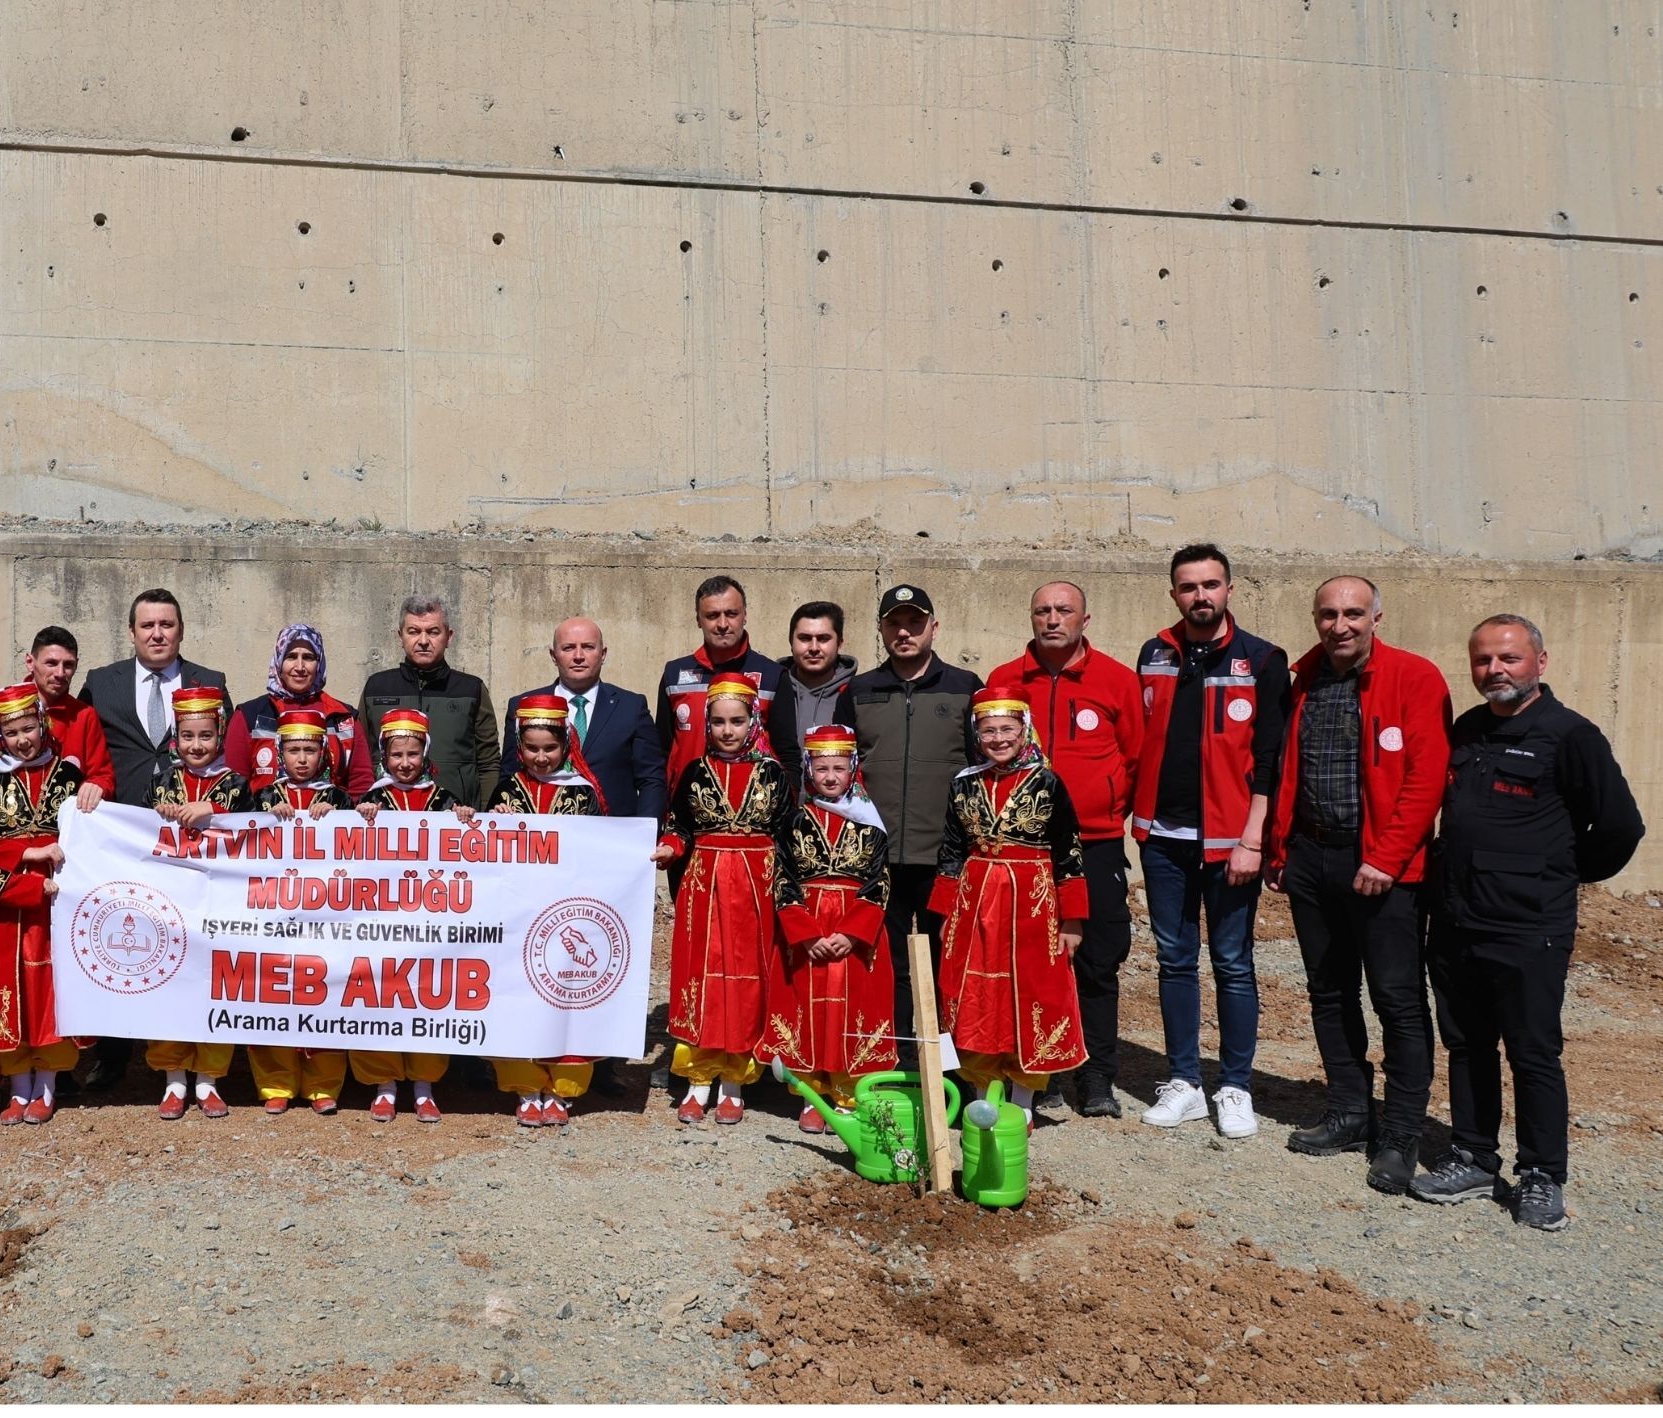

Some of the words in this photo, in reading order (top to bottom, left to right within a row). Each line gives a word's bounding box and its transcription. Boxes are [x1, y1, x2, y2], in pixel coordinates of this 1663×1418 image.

[152, 820, 283, 859] ARTVİN
[293, 818, 325, 859] İL
[334, 819, 429, 860] MİLLİ
[439, 820, 558, 864] EĞİTİM
[247, 868, 473, 913] MÜDÜRLÜĞÜ
[560, 907, 593, 921] EĞİTİM
[263, 917, 325, 940] SAĞLIK
[330, 921, 352, 940] VE
[447, 921, 503, 944] BİRİMİ
[210, 949, 328, 1006] MEB
[340, 956, 491, 1011] AKUB
[539, 973, 566, 998] ARAMA
[568, 972, 614, 999] KURTARMA
[574, 971, 597, 979] AKUB
[207, 1008, 289, 1033] (Arama
[298, 1013, 403, 1037] Kurtarma
[411, 1016, 487, 1046] Birliği)
